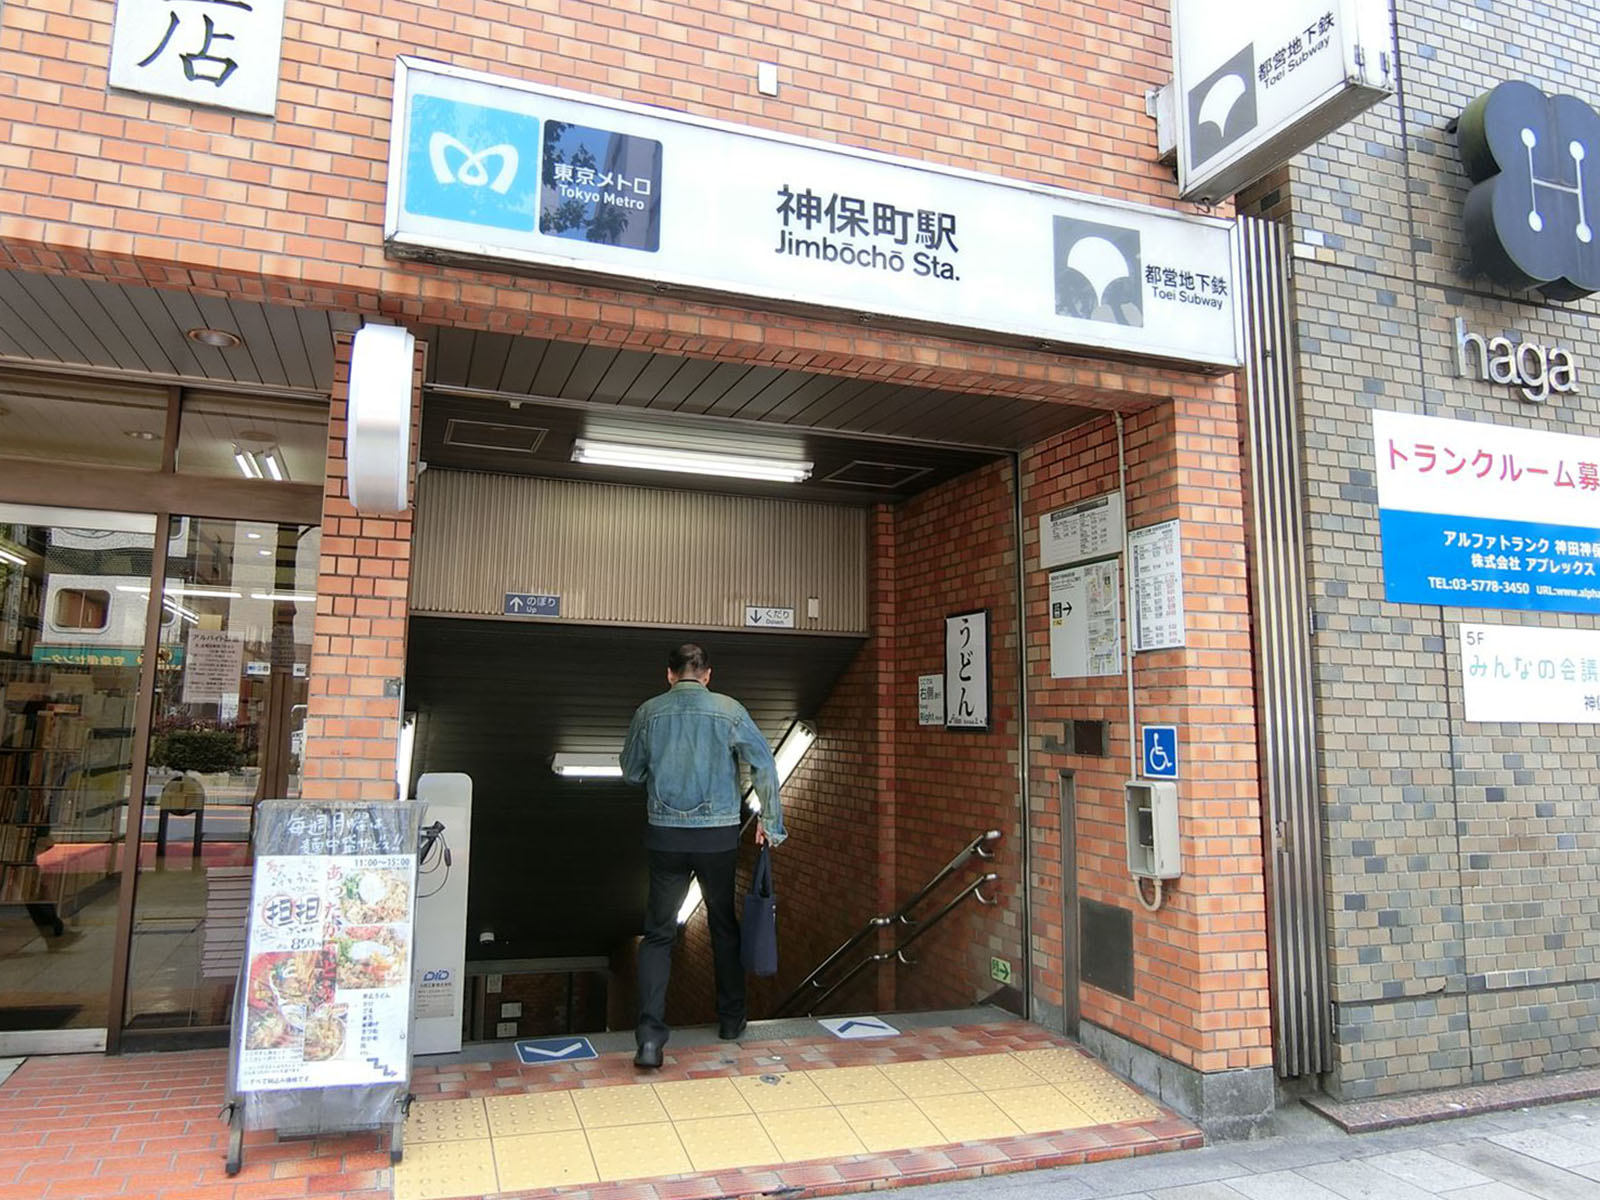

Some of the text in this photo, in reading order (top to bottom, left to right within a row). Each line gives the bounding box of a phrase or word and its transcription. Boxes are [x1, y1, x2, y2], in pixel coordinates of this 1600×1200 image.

[1258, 11, 1335, 81] 都営地下鉄
[1264, 36, 1330, 88] Toei Subway
[553, 163, 651, 195] 東京メトロ
[560, 184, 645, 210] Tokyo Metro
[776, 184, 959, 253] 神保町駅
[775, 230, 961, 281] Jimbōchō Sta.
[1145, 264, 1228, 296] 都営地下鉄
[1152, 286, 1223, 310] Toei Subway
[1455, 316, 1580, 401] haga
[1388, 438, 1600, 492] トランクルーム募
[1443, 531, 1550, 553] アルファトランク
[1471, 553, 1521, 571] 株式会社
[1428, 576, 1530, 595] TEL:03-5778-3450
[526, 596, 556, 607] のぼり
[766, 609, 790, 620] くだり
[1466, 631, 1485, 646] 5F
[957, 618, 975, 717] うどん
[1584, 694, 1600, 711] 神
